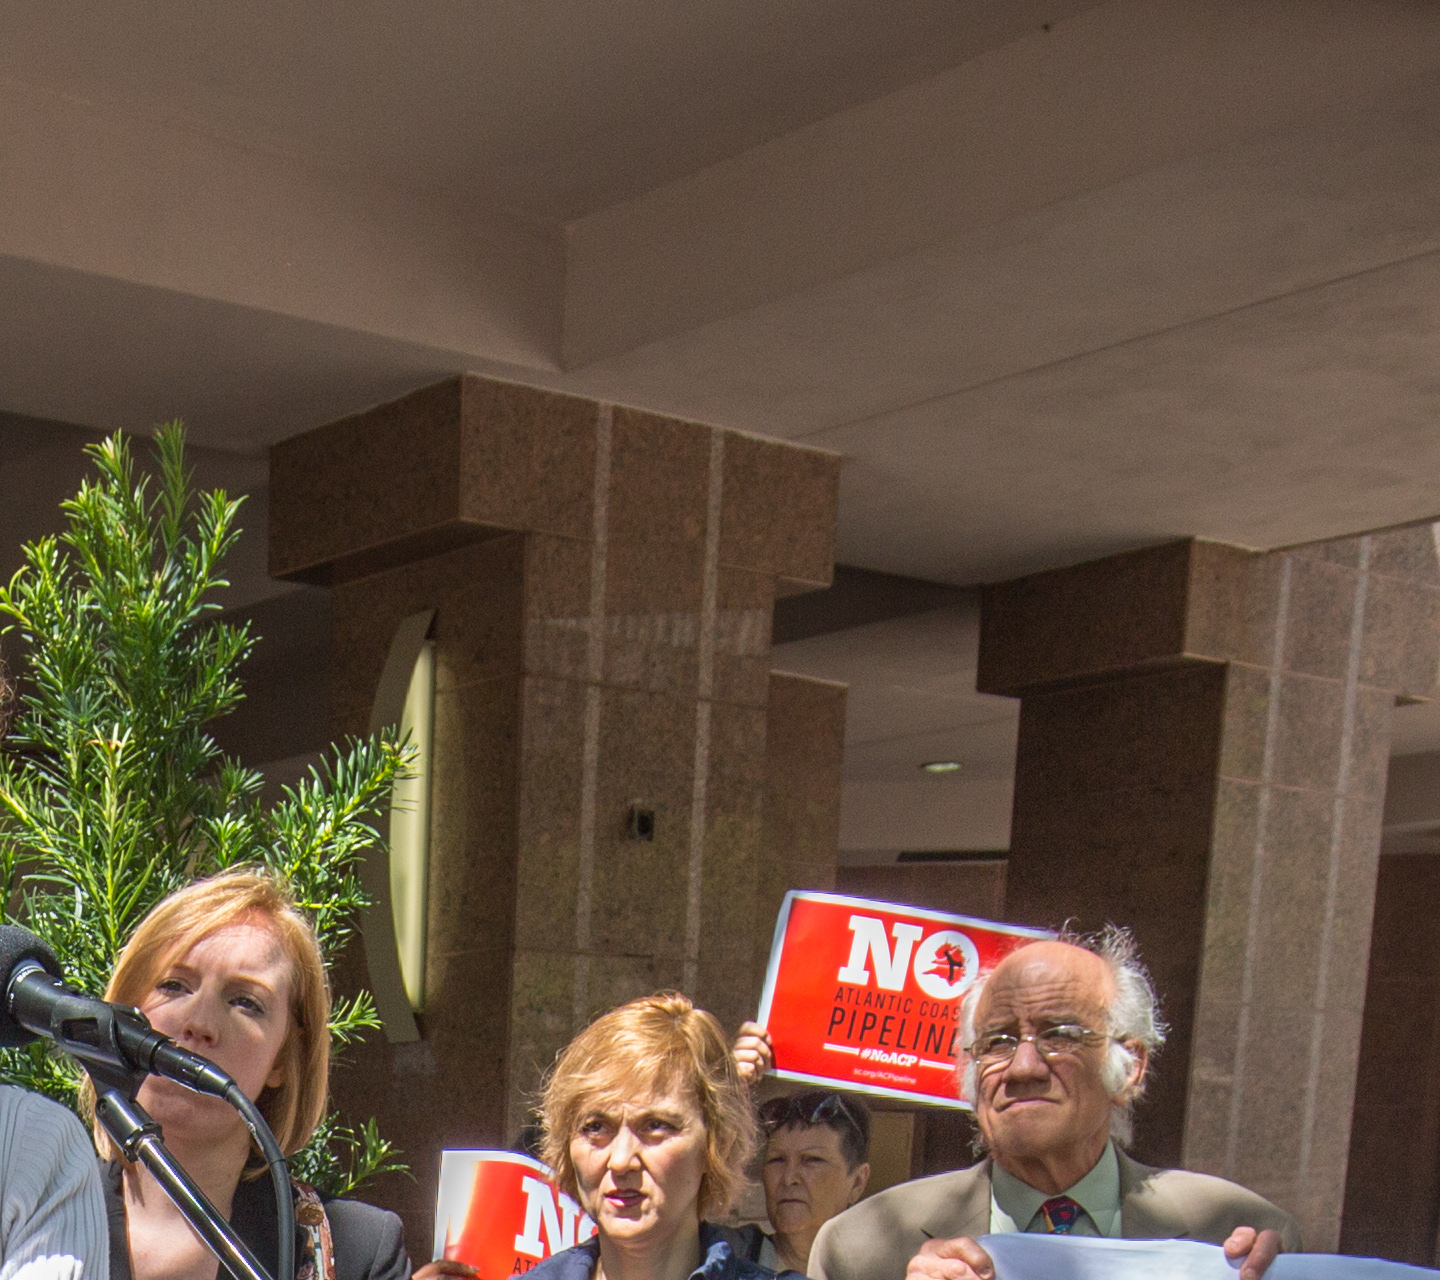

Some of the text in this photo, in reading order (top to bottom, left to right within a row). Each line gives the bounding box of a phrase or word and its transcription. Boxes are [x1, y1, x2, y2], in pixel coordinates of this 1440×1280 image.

[837, 914, 980, 1000] NO
[834, 986, 961, 1022] ATLANTIC COAS
[860, 1048, 918, 1067] #NoACP
